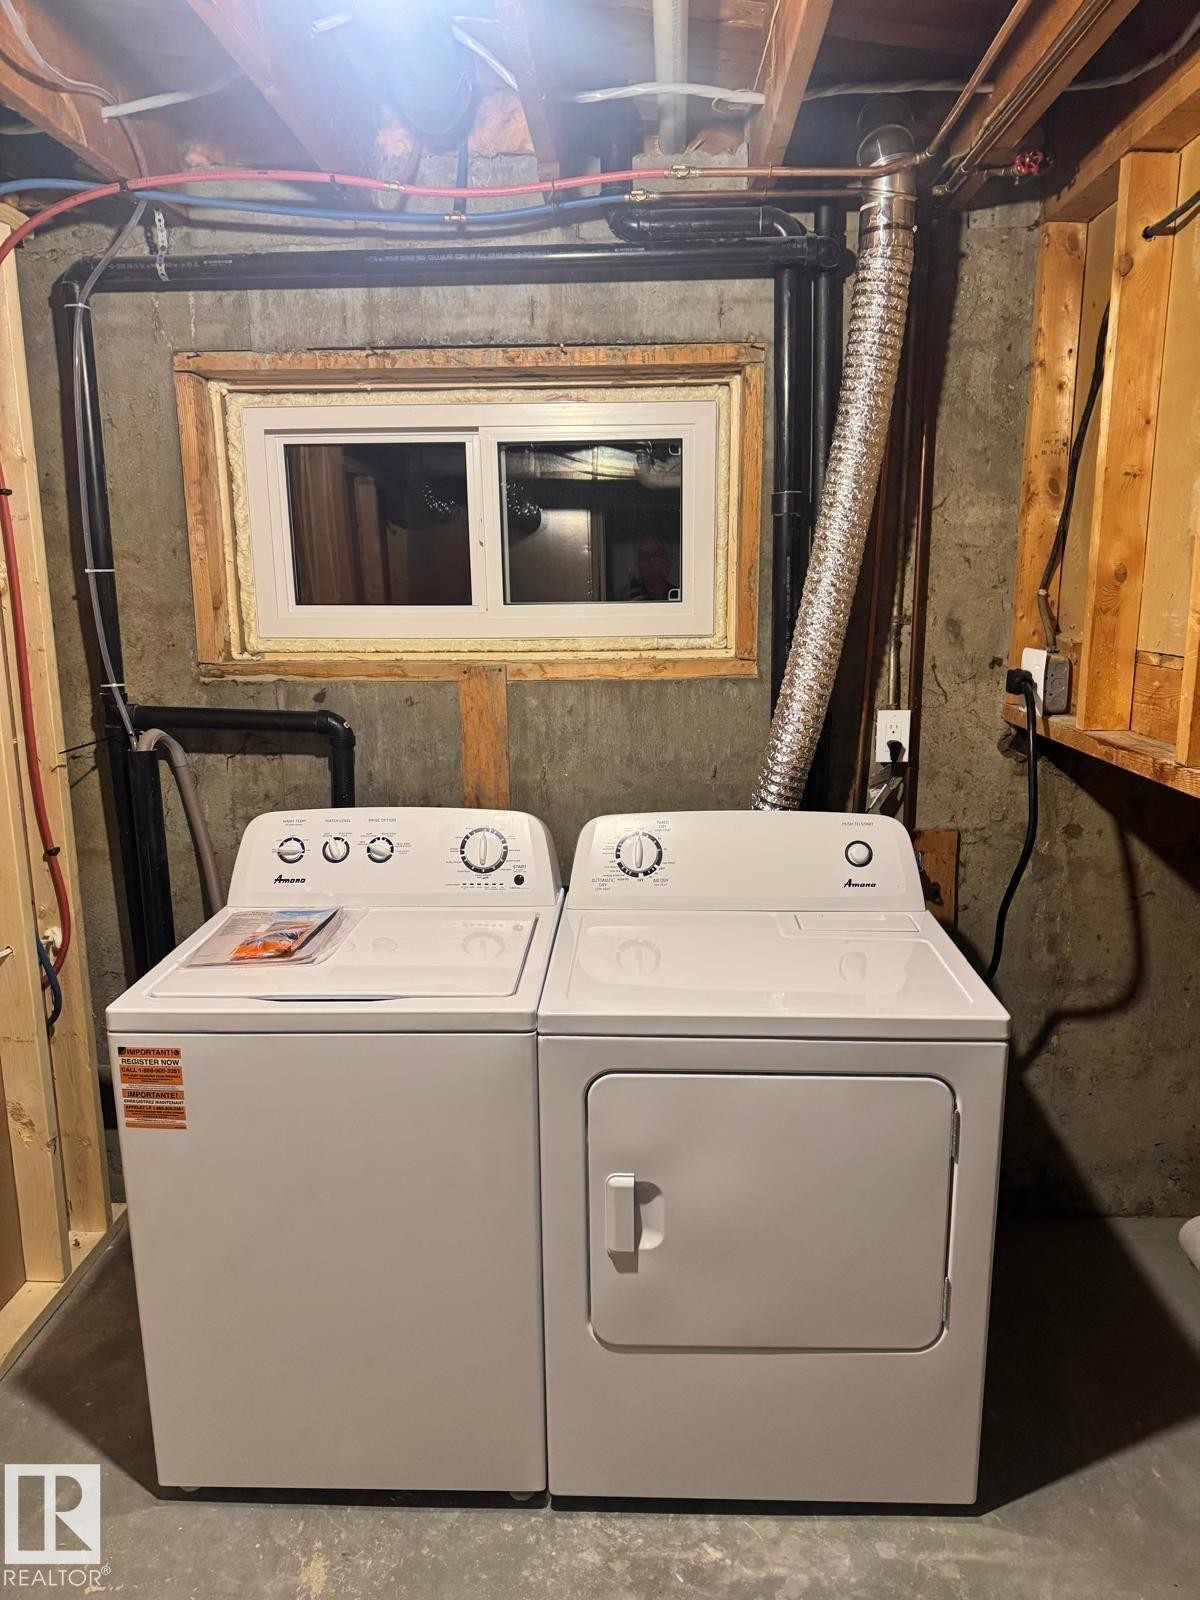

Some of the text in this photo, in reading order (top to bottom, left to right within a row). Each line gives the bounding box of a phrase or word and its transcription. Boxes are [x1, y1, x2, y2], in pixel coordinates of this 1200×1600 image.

[273, 874, 306, 884] Amana
[843, 878, 877, 888] Amana
[127, 1048, 173, 1056] IMPORTANT!
[121, 1058, 159, 1066] REGISTER
[127, 1091, 178, 1099] IMPORTANTE!
